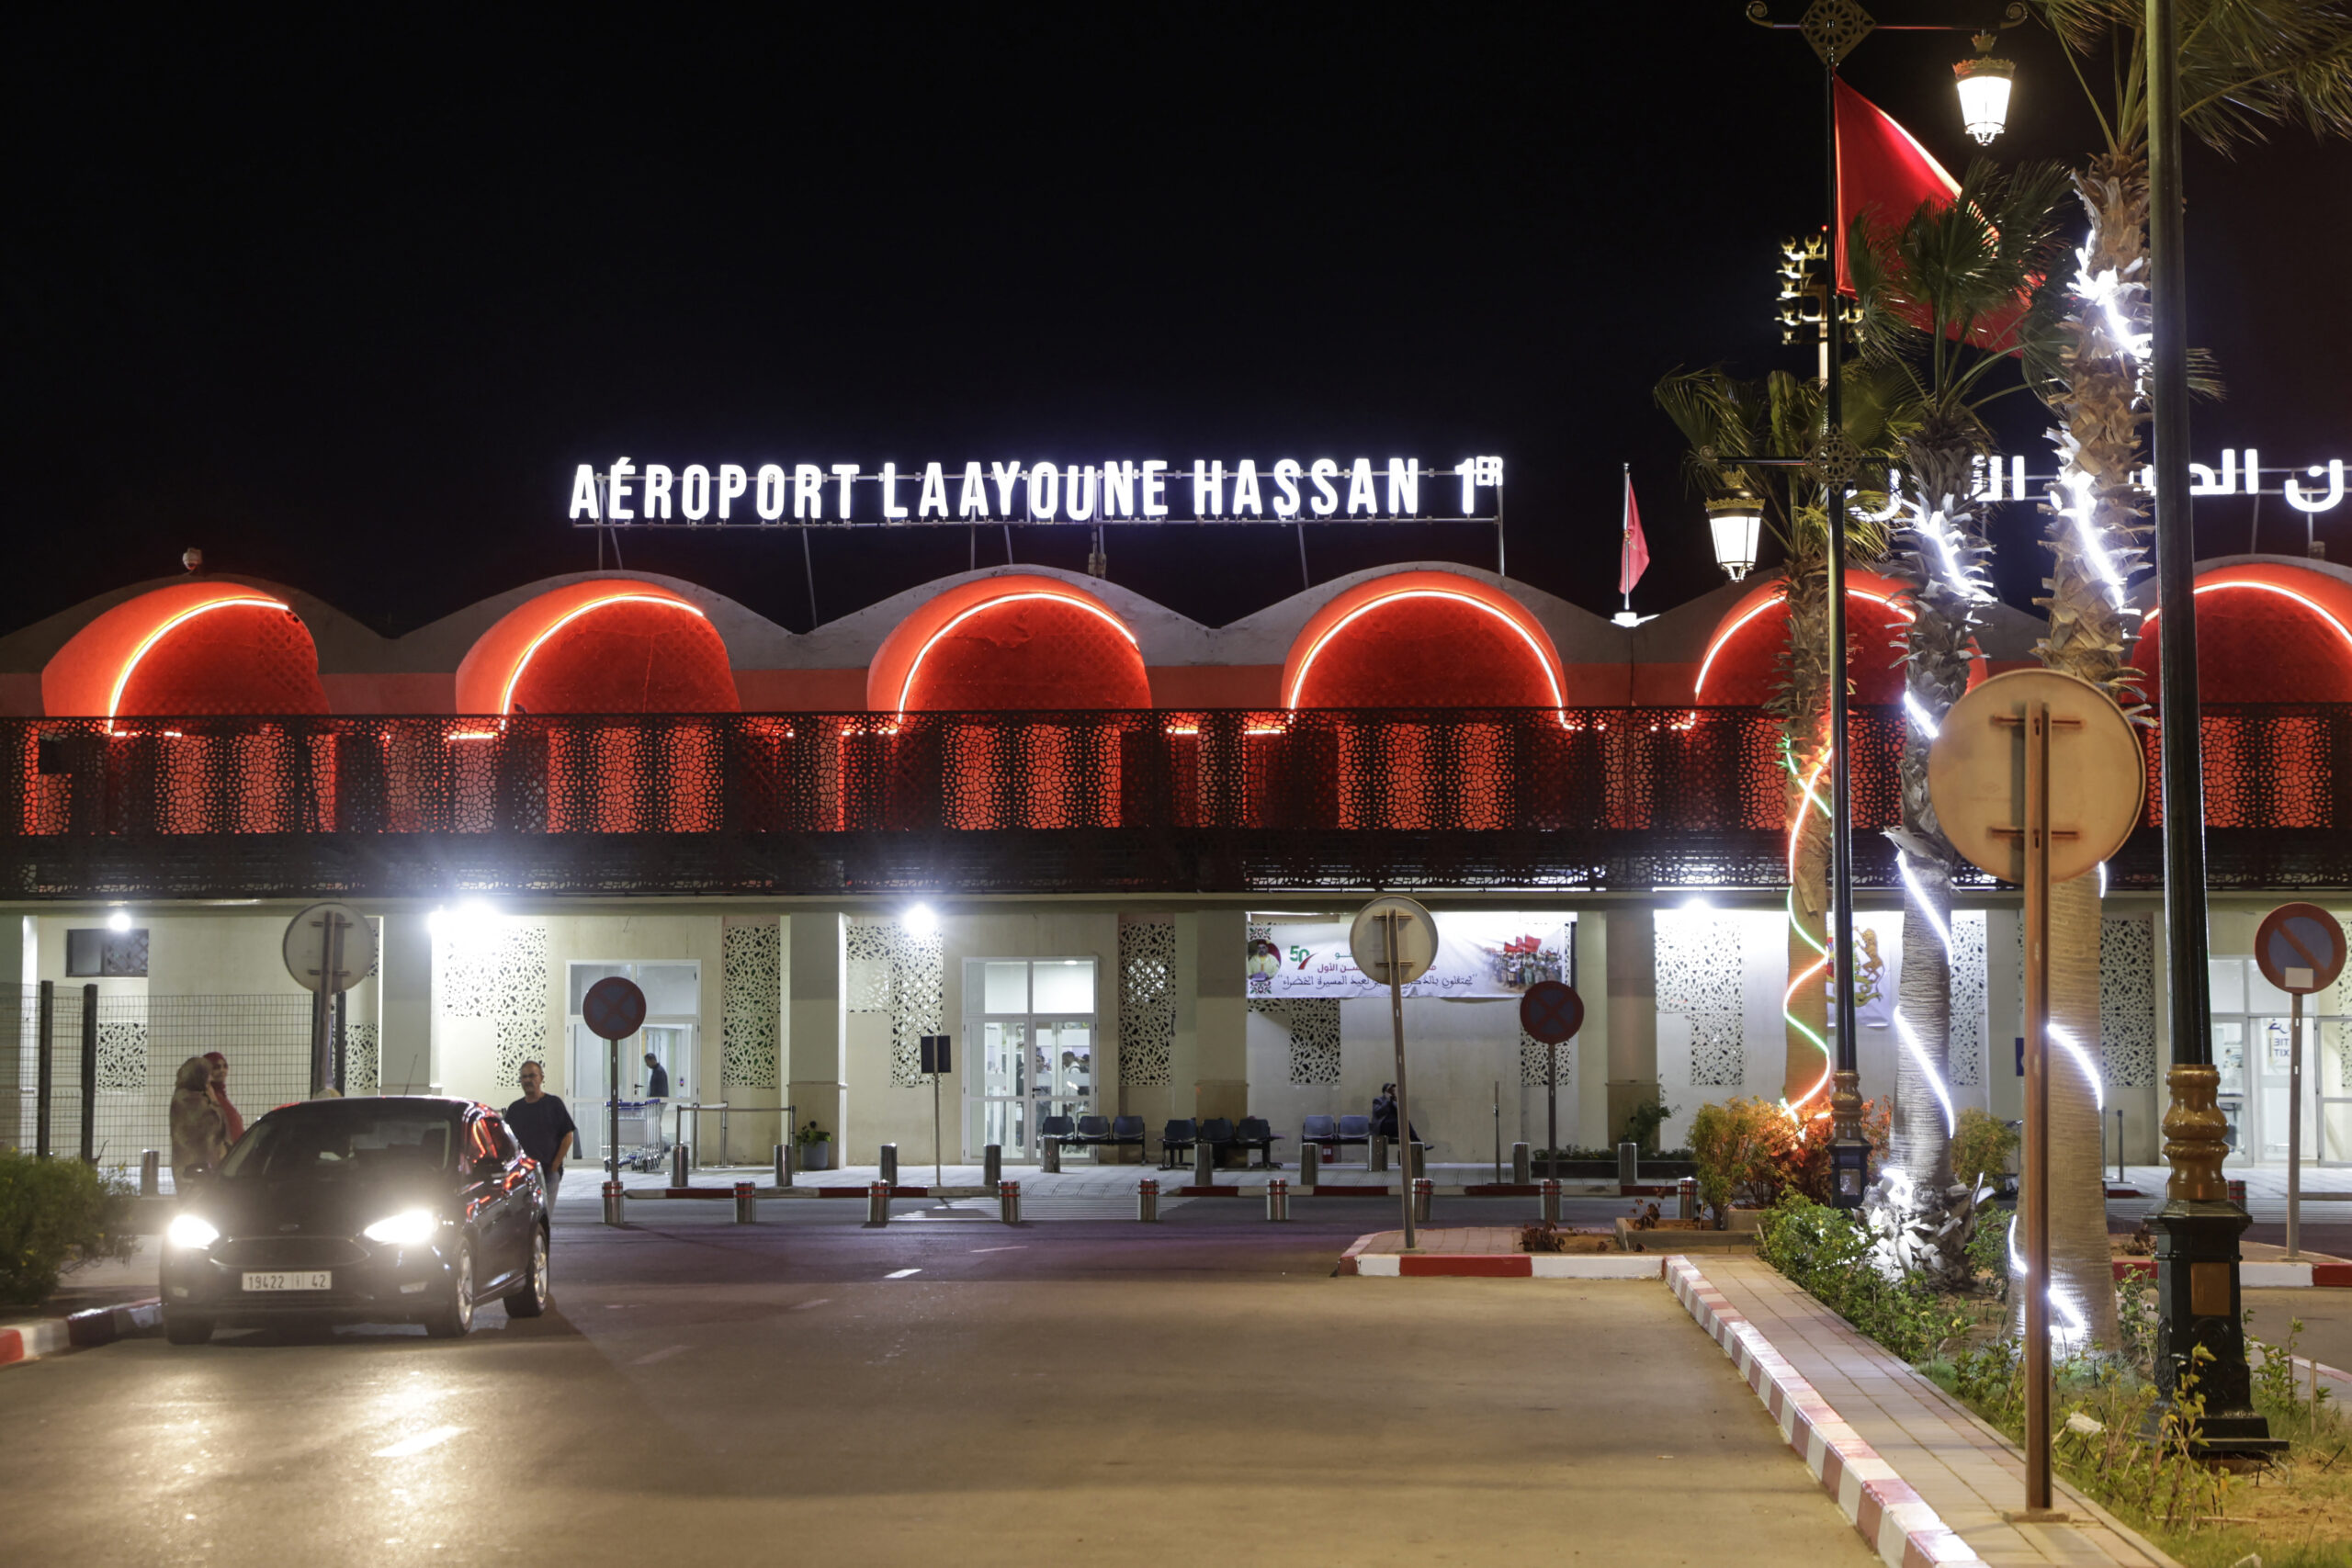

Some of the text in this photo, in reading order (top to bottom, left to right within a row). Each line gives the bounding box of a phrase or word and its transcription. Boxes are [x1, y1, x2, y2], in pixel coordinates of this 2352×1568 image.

[569, 457, 859, 520] AÉROPORT
[878, 460, 1168, 522] LAAYOUNE
[1193, 457, 1419, 516] HASSAN
[248, 1275, 285, 1289] 19422
[311, 1274, 326, 1288] 42
